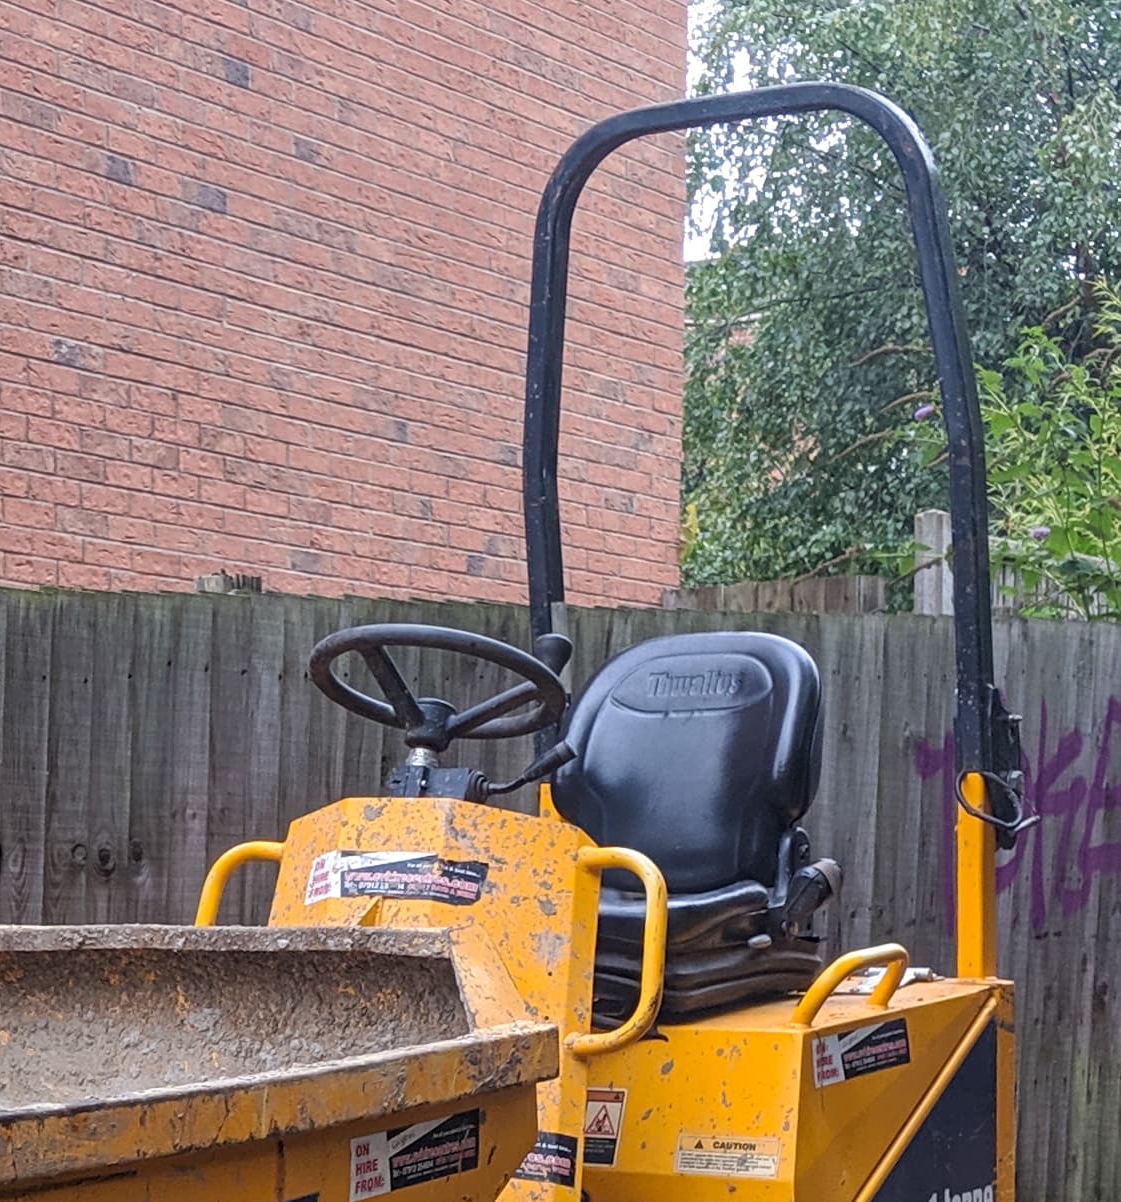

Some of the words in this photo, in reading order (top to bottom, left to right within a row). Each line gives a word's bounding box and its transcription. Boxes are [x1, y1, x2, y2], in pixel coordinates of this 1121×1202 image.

[647, 671, 740, 697] Thwaites
[355, 1143, 369, 1157] ON
[713, 1141, 756, 1151] CAUTION
[355, 1159, 378, 1176] HIRE
[355, 1175, 384, 1194] FROM:
